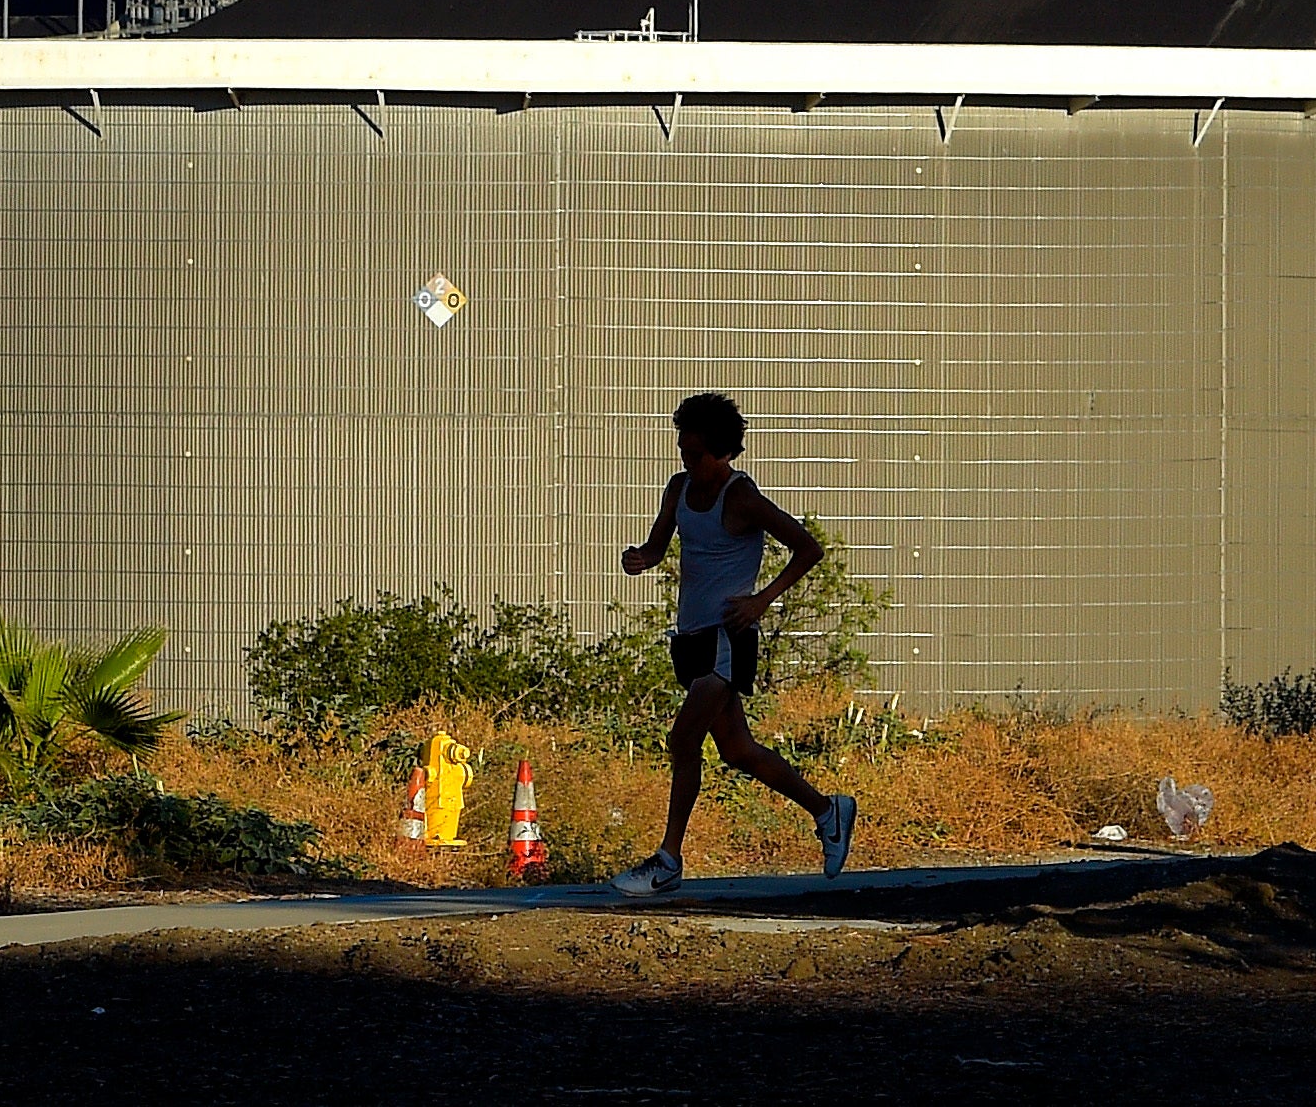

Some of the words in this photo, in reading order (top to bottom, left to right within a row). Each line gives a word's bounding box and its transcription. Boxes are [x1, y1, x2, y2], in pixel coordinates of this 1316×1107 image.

[435, 277, 445, 295] 2
[419, 292, 431, 308] 0
[448, 293, 460, 308] 0
